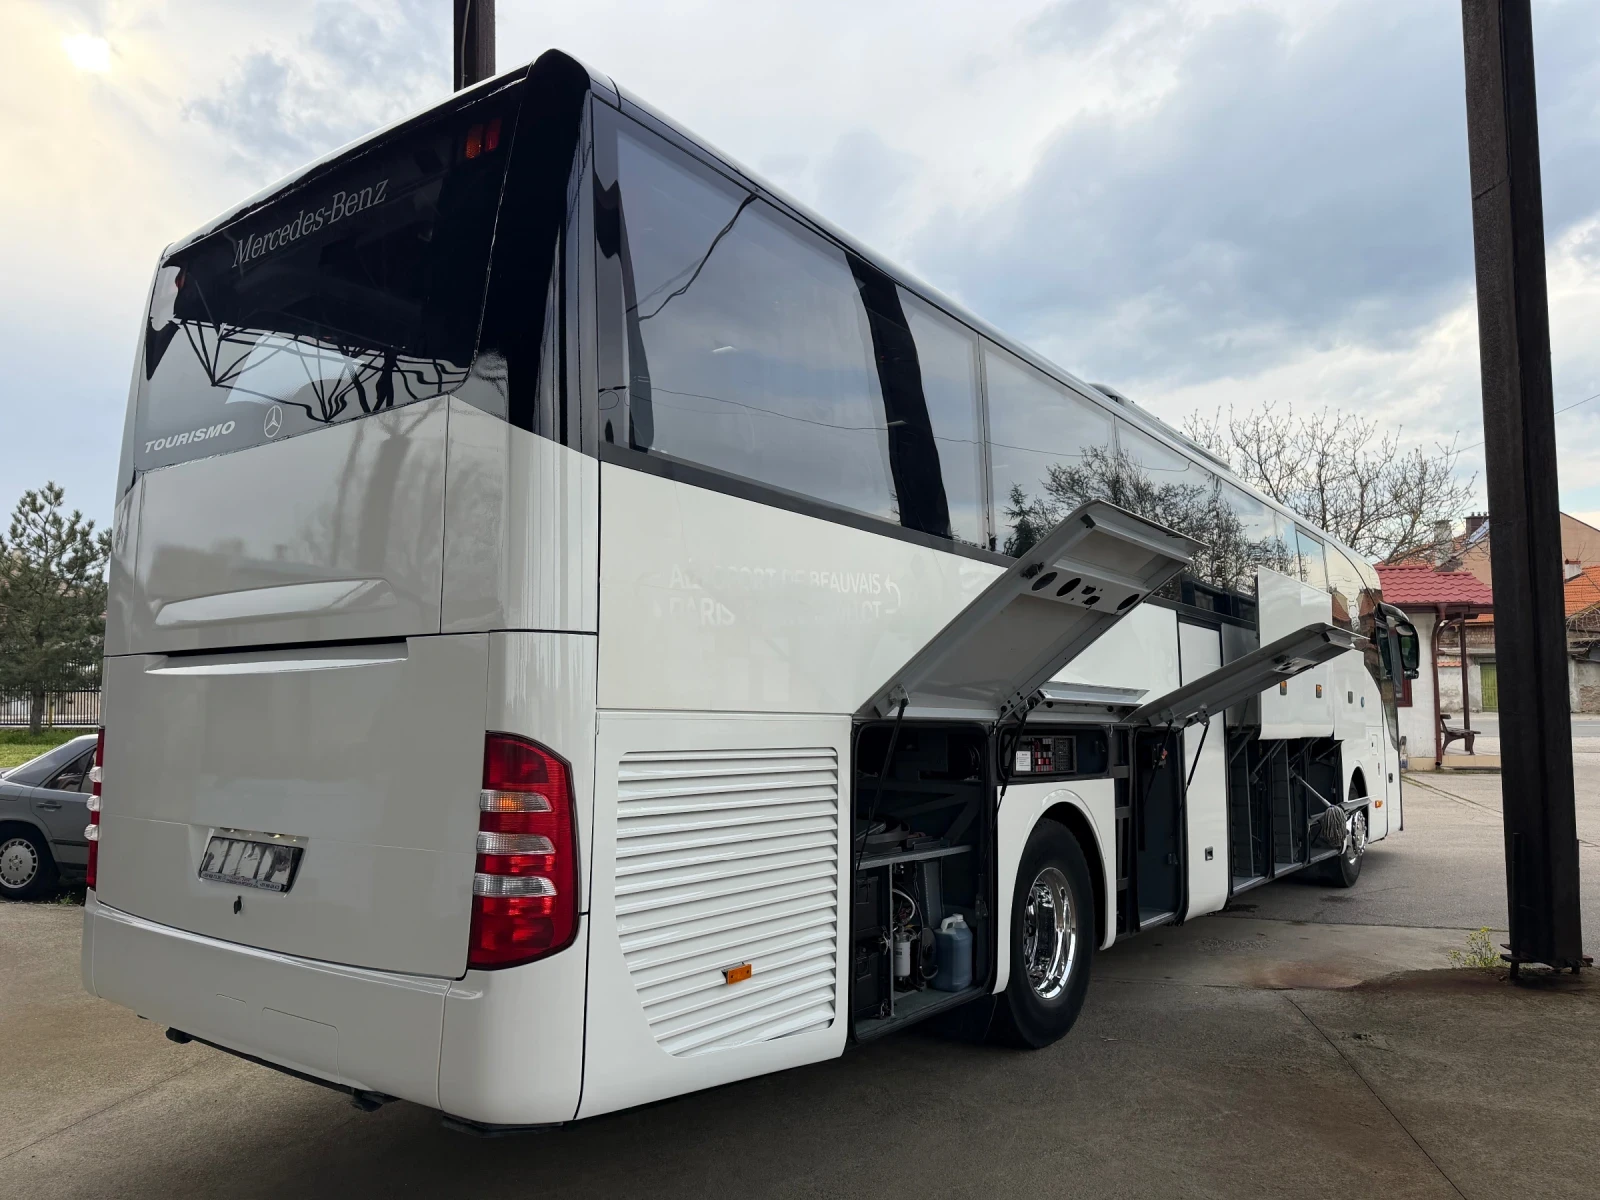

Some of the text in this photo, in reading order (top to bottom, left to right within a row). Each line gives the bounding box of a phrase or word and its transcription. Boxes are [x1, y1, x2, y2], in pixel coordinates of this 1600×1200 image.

[232, 179, 389, 269] Mercedes-Benz
[145, 420, 236, 454] TOURISMO
[809, 570, 881, 596] BEAUVAIS
